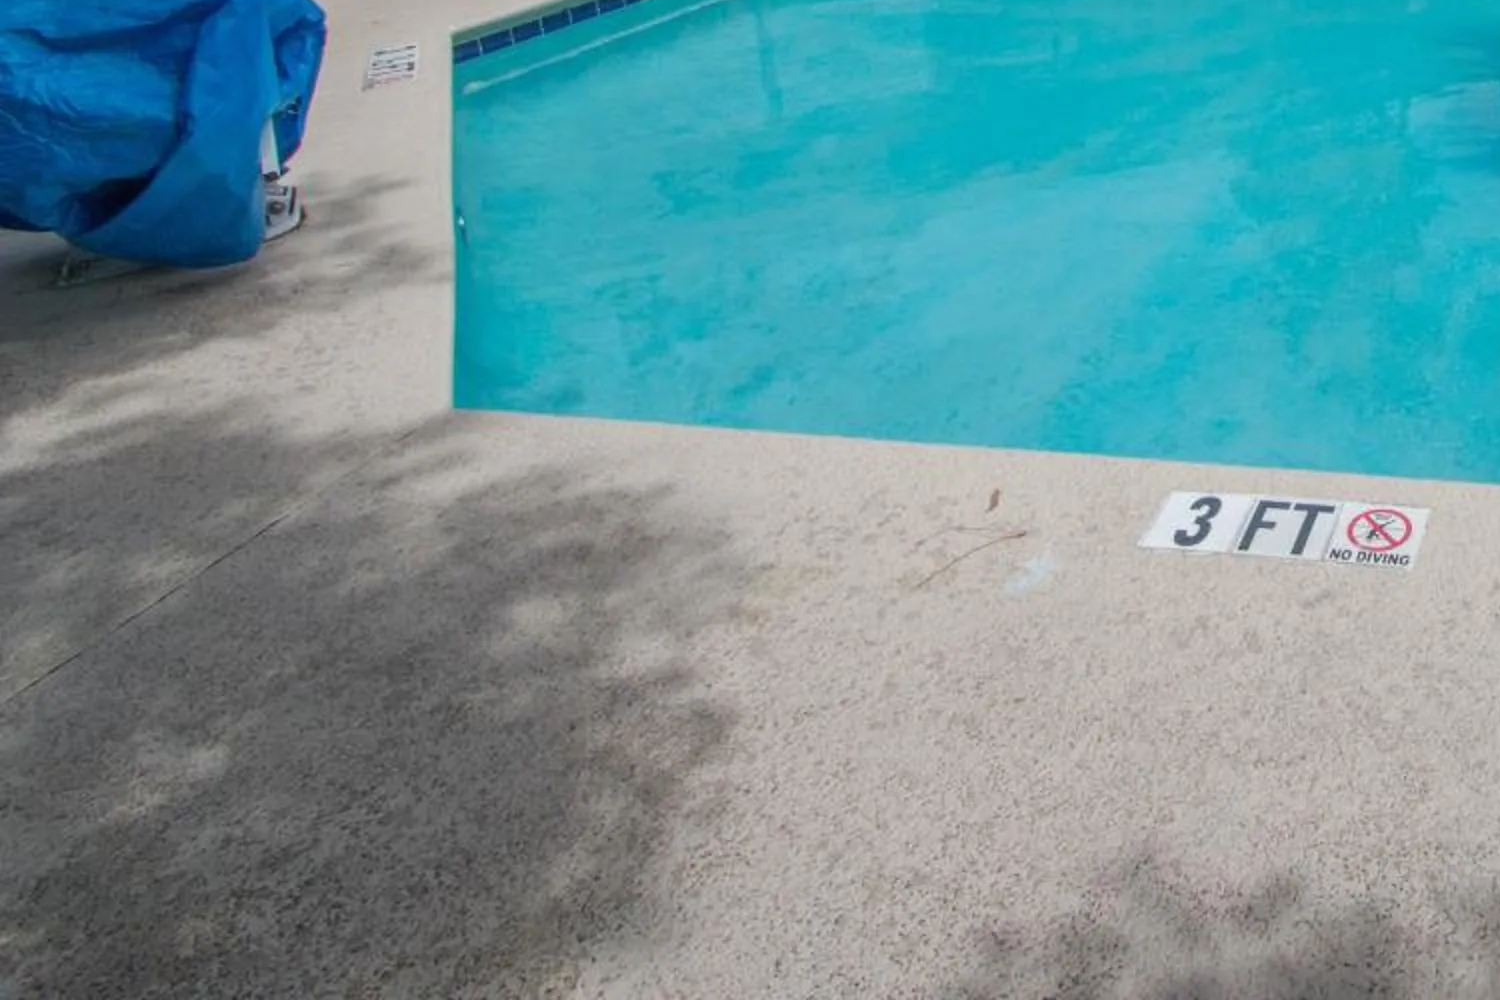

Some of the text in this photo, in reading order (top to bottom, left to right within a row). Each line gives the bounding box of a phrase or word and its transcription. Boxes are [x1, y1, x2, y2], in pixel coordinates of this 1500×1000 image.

[1172, 495, 1336, 555] 3 FT
[1329, 548, 1411, 566] NO DIVING
